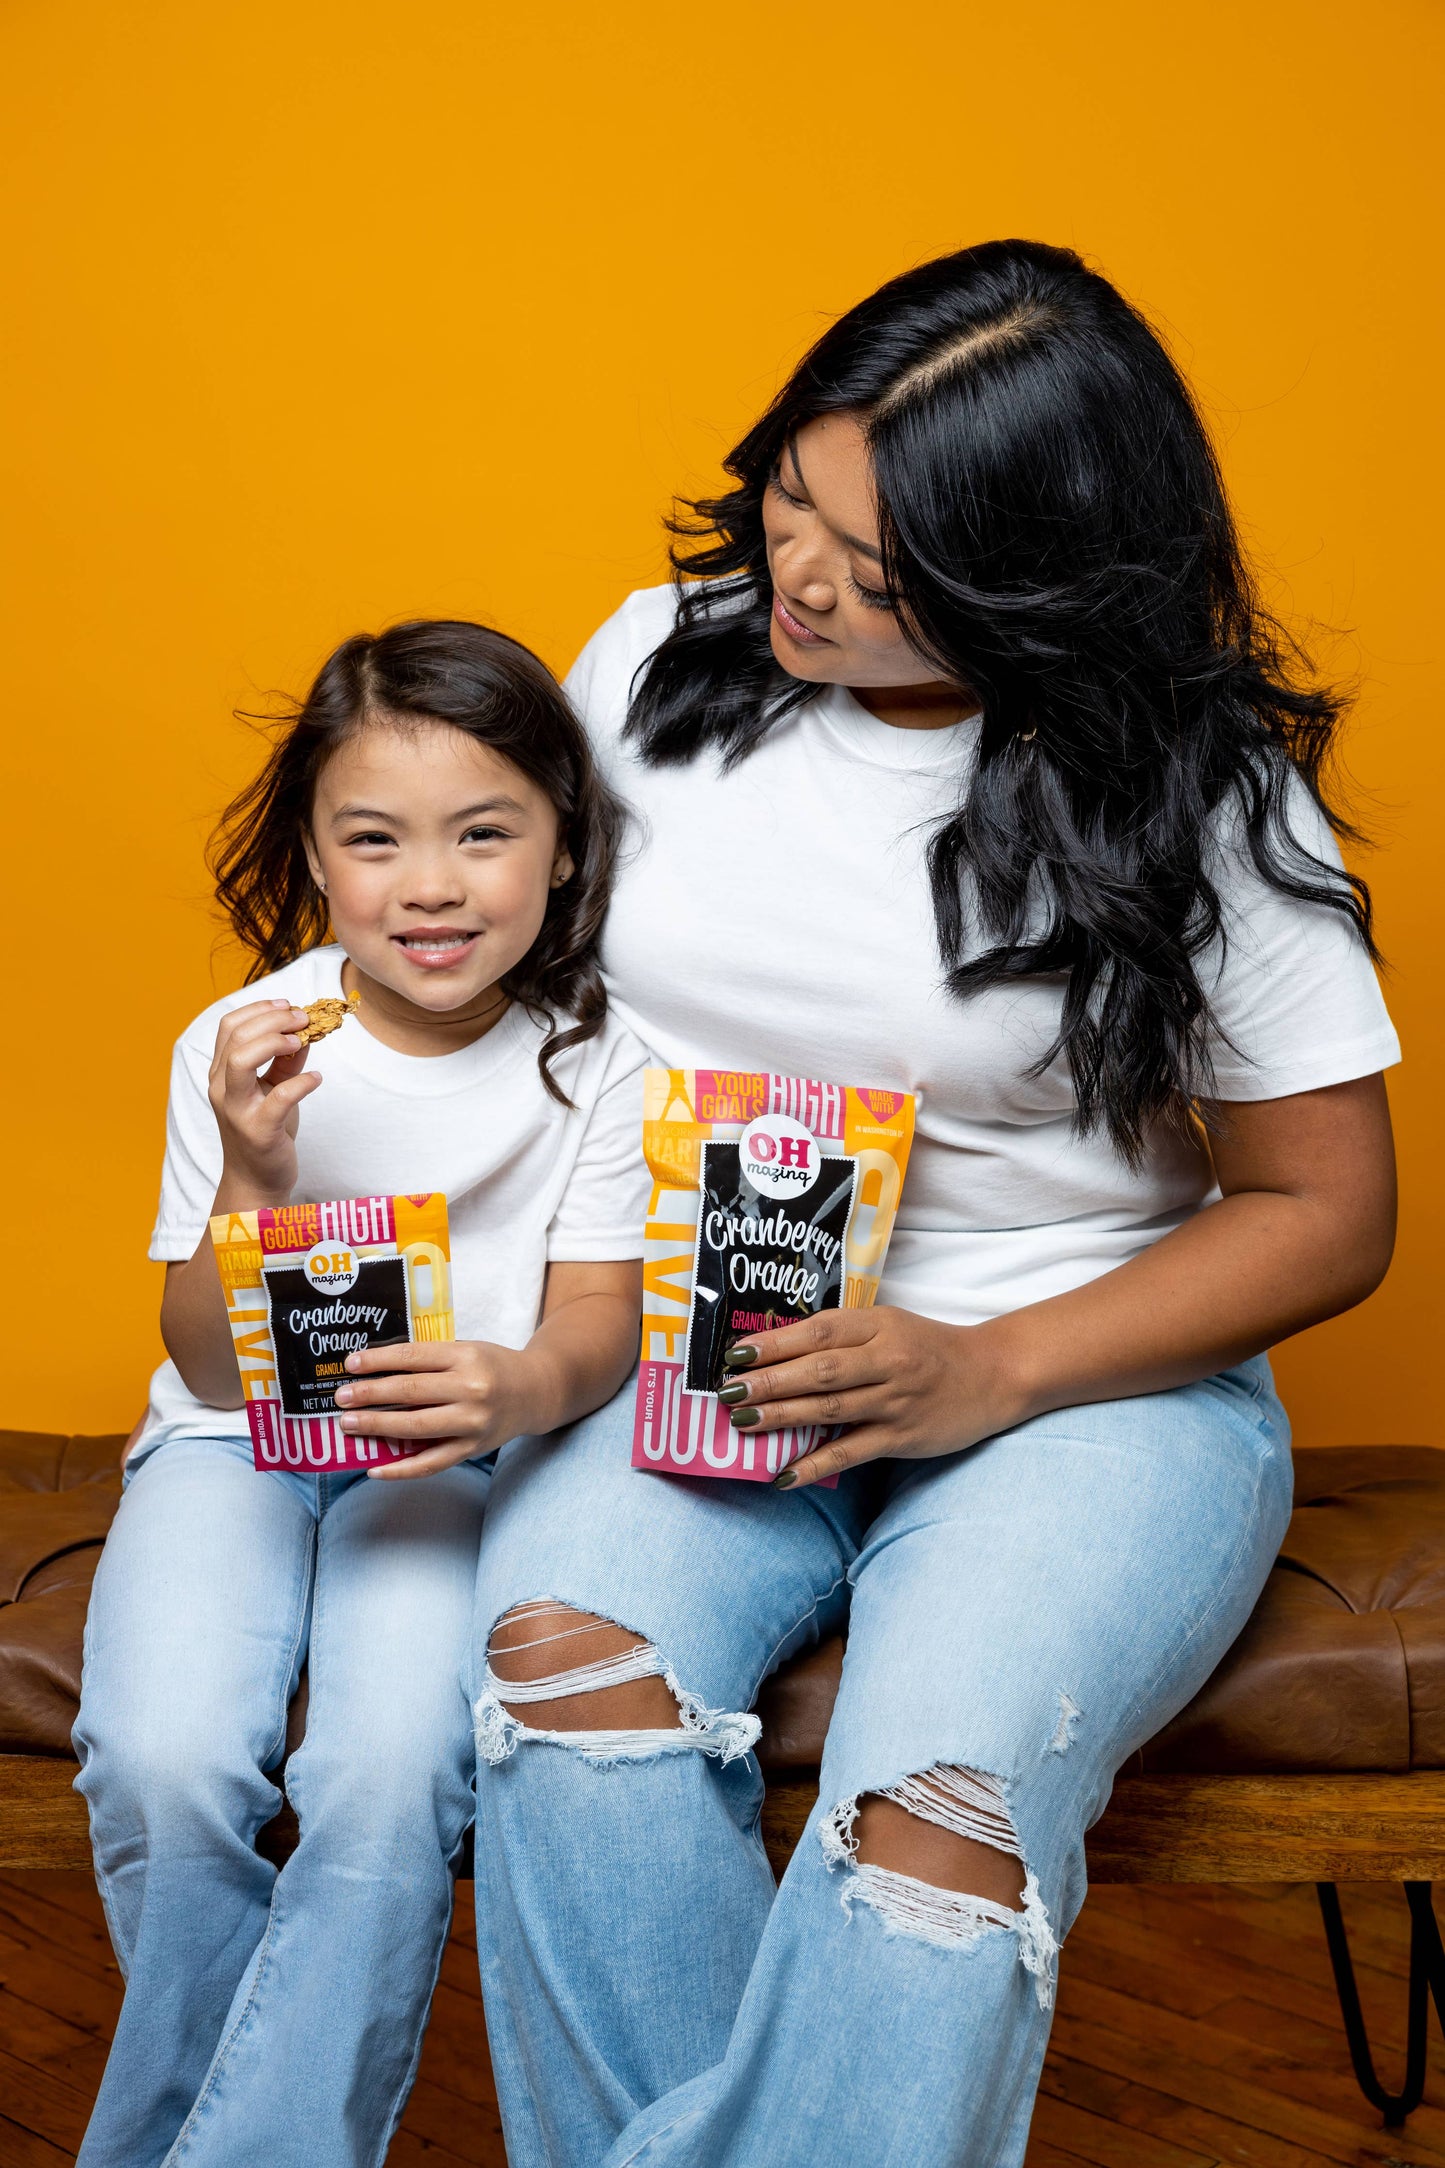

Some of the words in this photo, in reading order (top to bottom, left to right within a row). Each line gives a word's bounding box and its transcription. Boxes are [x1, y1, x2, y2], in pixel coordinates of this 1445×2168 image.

[713, 1073, 765, 1099] YOUR
[868, 1090, 895, 1104] MADE
[702, 1094, 764, 1121] GOALS
[768, 1074, 841, 1137] HIGH
[870, 1101, 895, 1115] WITH
[748, 1132, 811, 1169] OH
[747, 1163, 812, 1188] mazing
[272, 1203, 317, 1226] YOUR
[320, 1196, 391, 1243] HIGH
[263, 1223, 320, 1250] GOALS
[705, 1209, 841, 1274] Cranberry
[220, 1249, 262, 1272] HARD
[310, 1252, 352, 1275] OH
[225, 1276, 262, 1287] HUMBL
[311, 1273, 354, 1285] mazing
[729, 1253, 820, 1306] Orange
[289, 1298, 388, 1334] Cranberry
[731, 1310, 773, 1332] GRANOLA
[309, 1331, 369, 1357] Orange
[315, 1361, 345, 1377] GRANOLA
[648, 1367, 657, 1388] IT'S
[303, 1397, 319, 1410] NET
[320, 1396, 336, 1409] WT.
[644, 1390, 655, 1421] YOUR
[256, 1419, 266, 1439] YOUR
